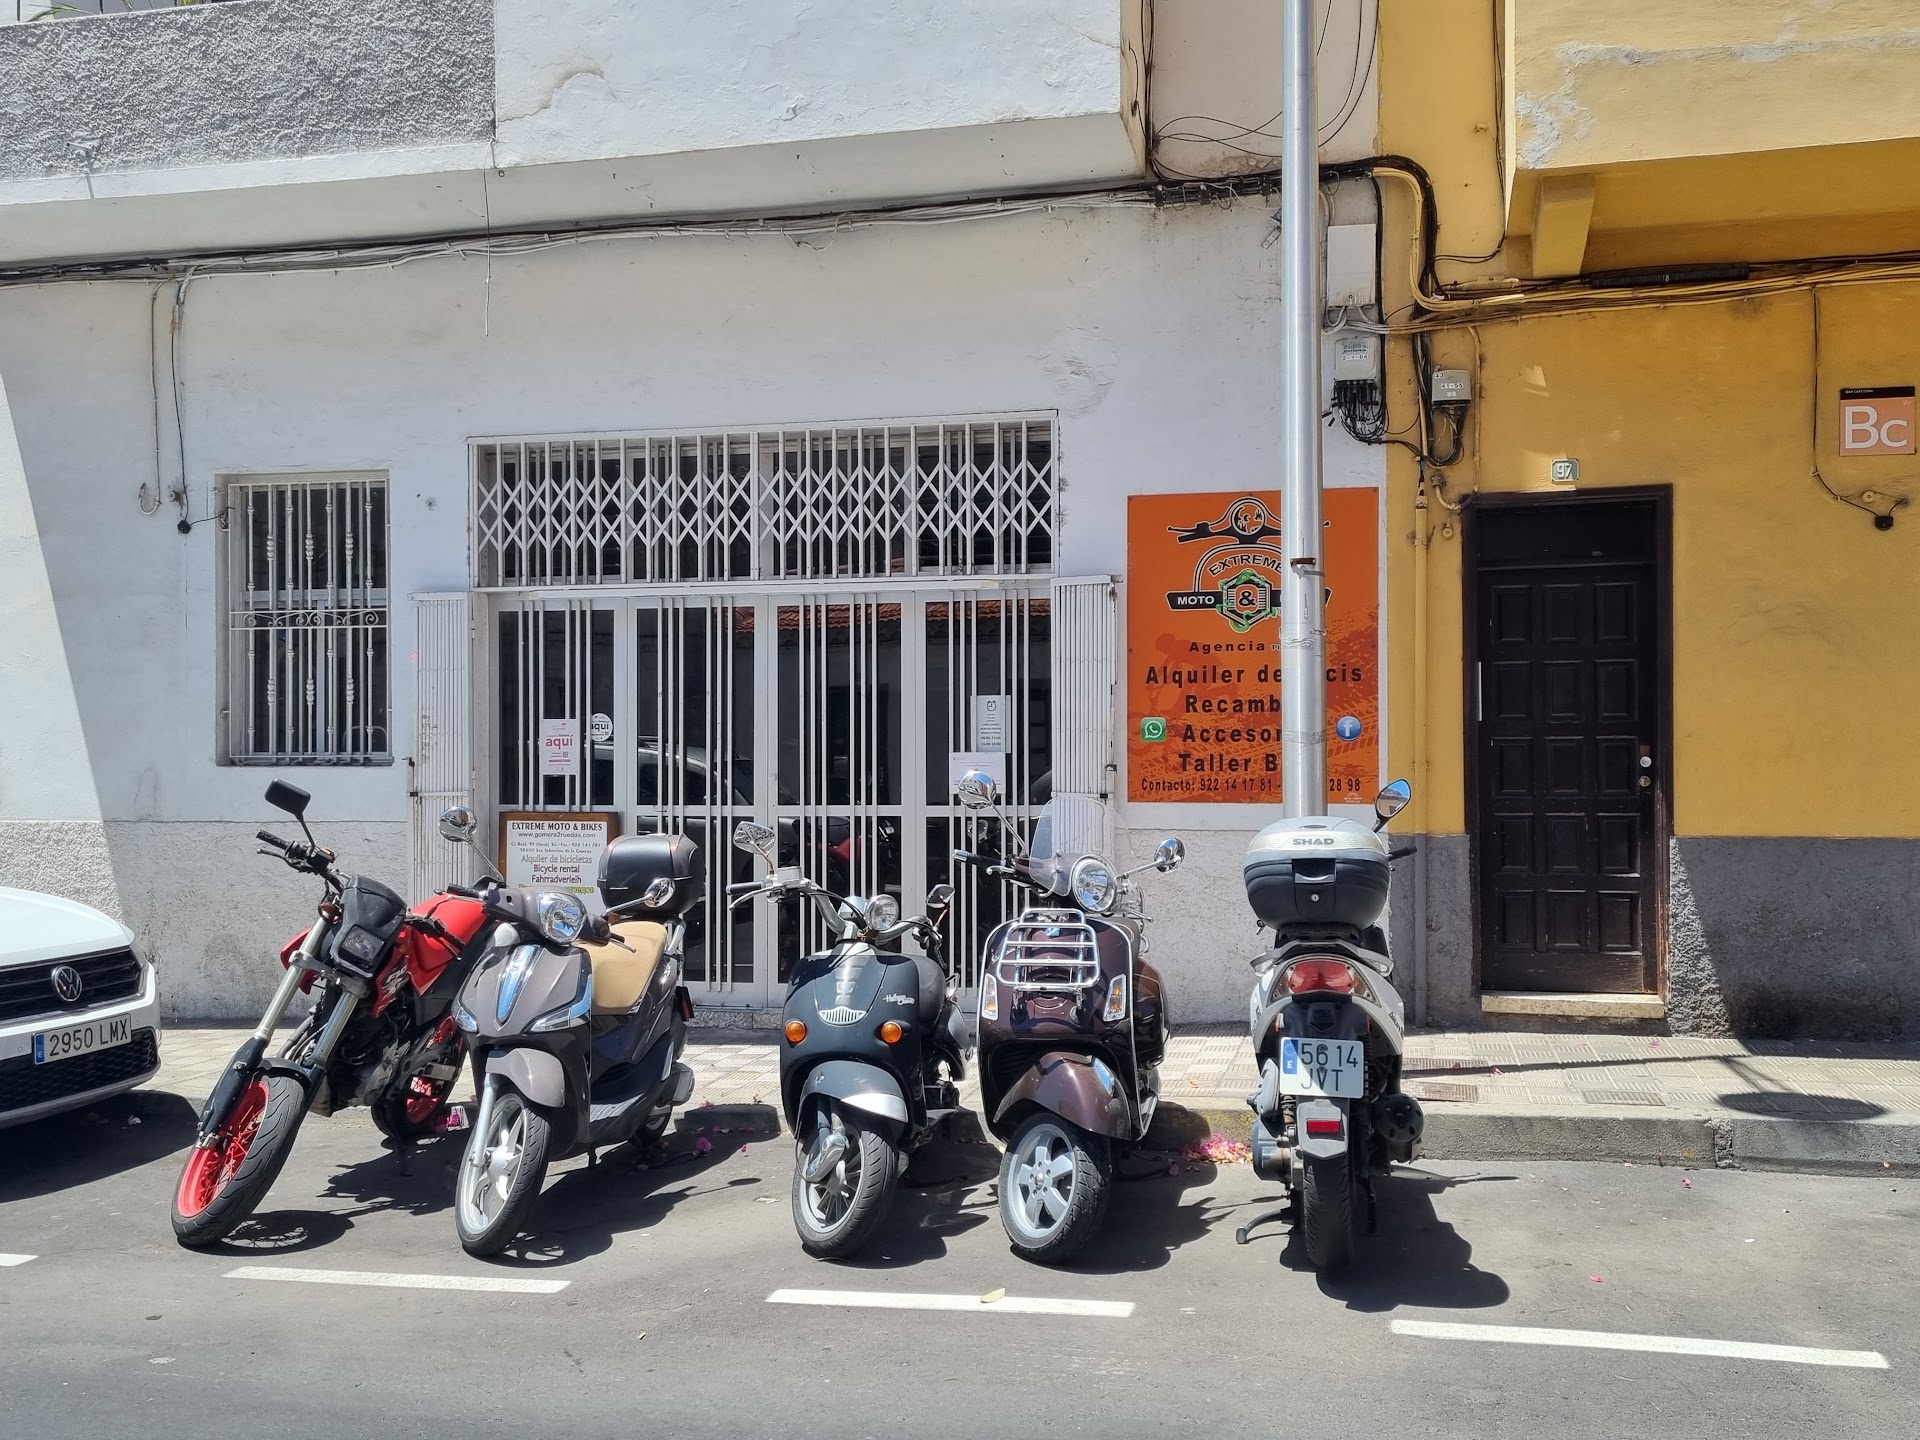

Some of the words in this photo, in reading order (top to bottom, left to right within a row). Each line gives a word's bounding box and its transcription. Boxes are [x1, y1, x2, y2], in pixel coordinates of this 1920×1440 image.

[1845, 406, 1908, 449] Bc
[1557, 462, 1574, 479] 97
[1208, 554, 1282, 577] EXTREME
[1177, 595, 1215, 606] MOTO
[1238, 590, 1256, 607] &
[1188, 641, 1266, 655] Agencia
[1145, 665, 1245, 689] Alquiler
[1326, 663, 1362, 682] cis
[1185, 694, 1282, 714] Recamb
[545, 734, 574, 750] aquí
[1182, 724, 1282, 743] Accesor
[1178, 753, 1252, 772] Taller
[1141, 778, 1195, 792] Contacto:
[1200, 778, 1220, 791] 922
[1225, 778, 1237, 791] 14
[1242, 778, 1255, 791] 17
[1260, 778, 1272, 791] 81
[1329, 778, 1342, 792] 28
[1347, 778, 1361, 792] 98
[511, 822, 546, 831] EXTREME
[547, 822, 571, 831] MOTO
[572, 823, 579, 831] &
[580, 823, 603, 831] BIKES
[1292, 837, 1335, 846] SHAD
[520, 854, 549, 865] Alquiler
[549, 854, 559, 864] de
[559, 855, 593, 864] bicicletas
[533, 864, 558, 875] Bicycle
[559, 864, 580, 873] rental
[531, 874, 582, 884] Fahrradverleih
[49, 1027, 93, 1057] 2950
[99, 1018, 129, 1046] LMX
[1286, 1060, 1294, 1069] E
[1300, 1067, 1344, 1092] JVT
